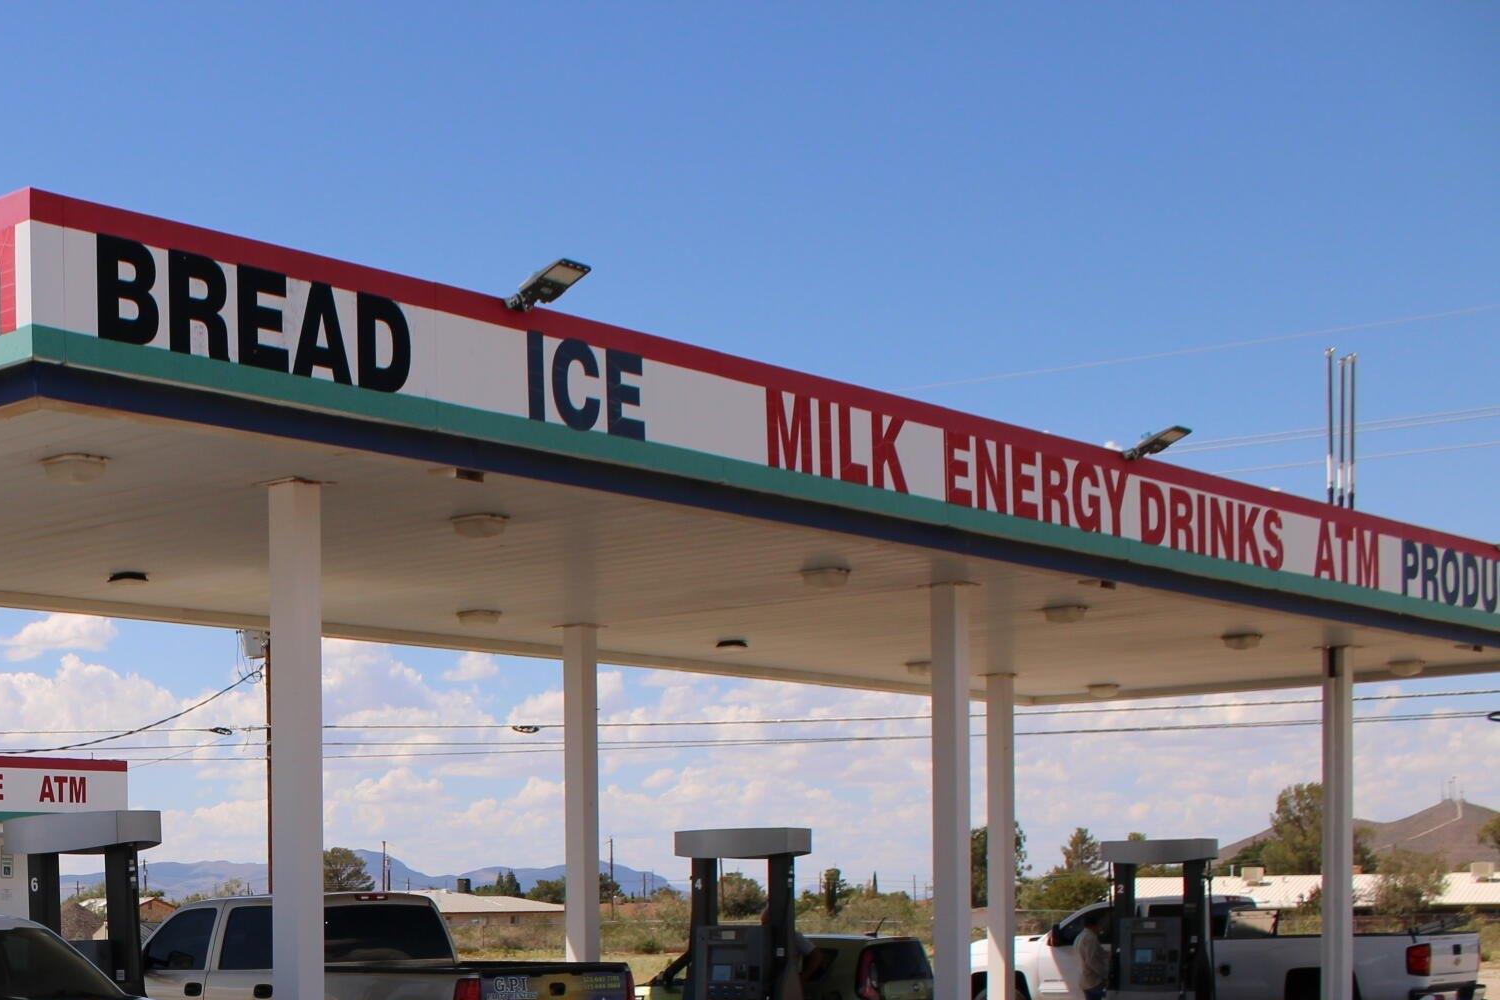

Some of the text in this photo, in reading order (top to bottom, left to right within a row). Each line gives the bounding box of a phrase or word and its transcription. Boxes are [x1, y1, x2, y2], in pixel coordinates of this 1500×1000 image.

[96, 232, 1498, 614] BREAD ICE MILK ENERGY DRINKS ATM PRODU
[38, 775, 87, 804] ATM
[31, 877, 39, 892] 6
[694, 878, 702, 890] 4
[1117, 884, 1125, 894] 2
